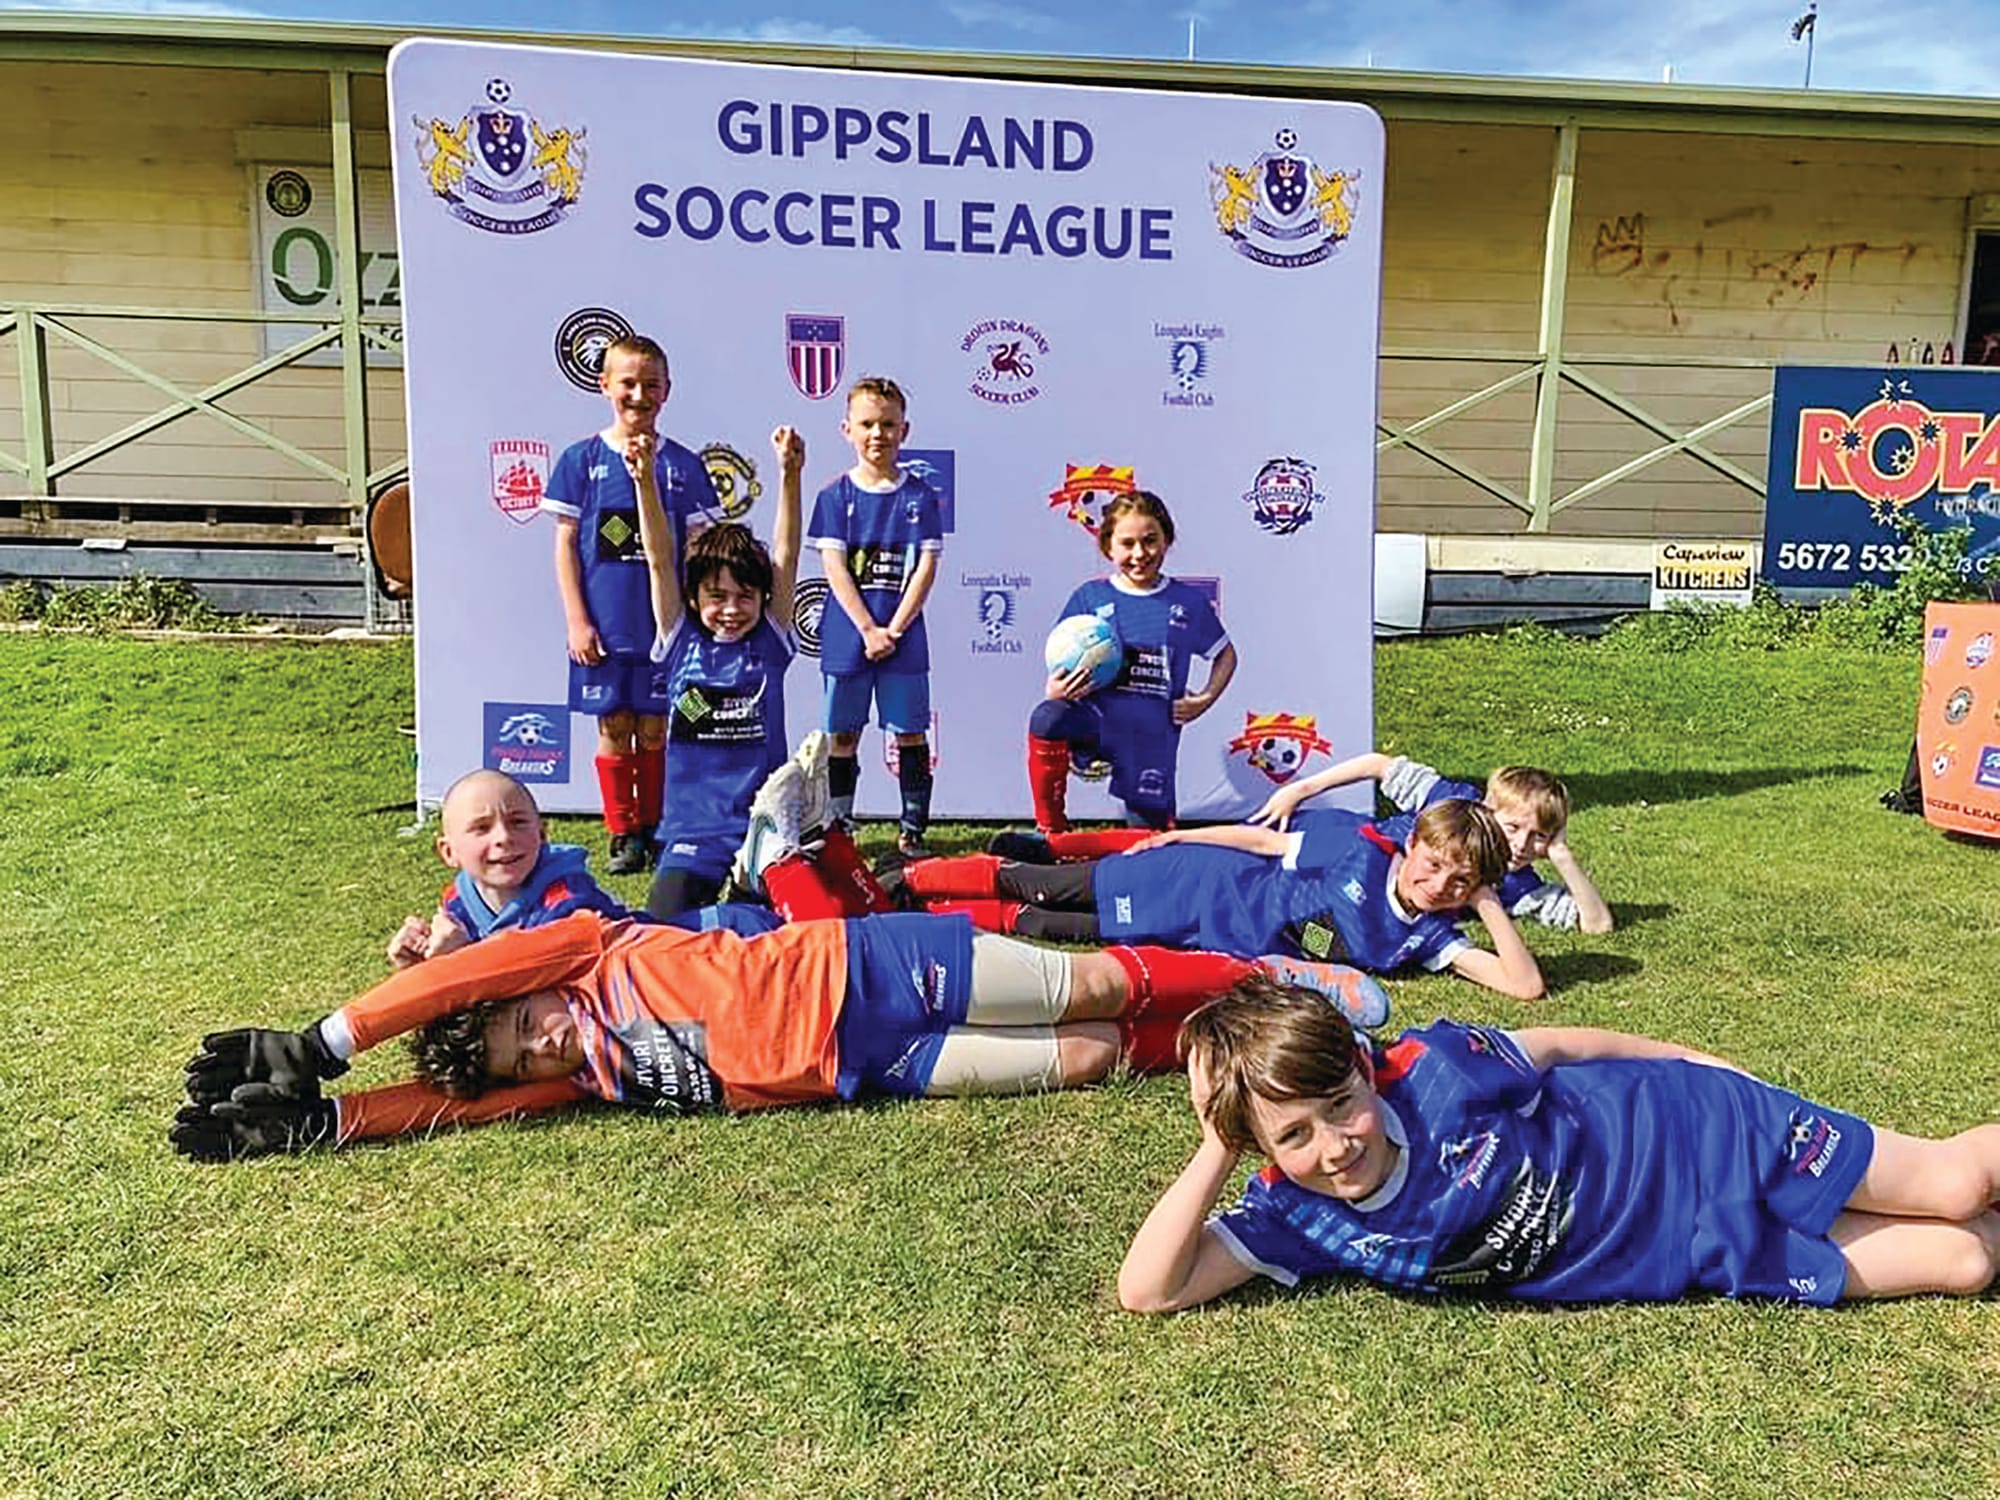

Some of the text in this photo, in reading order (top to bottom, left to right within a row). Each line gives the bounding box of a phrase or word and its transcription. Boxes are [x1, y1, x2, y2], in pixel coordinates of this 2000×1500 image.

[718, 99, 1094, 171] GIPPSLAND
[633, 183, 1173, 260] SOCCER LEAGUE
[1000, 320, 1049, 354] DRAGONS
[1795, 398, 2000, 506] ROTA
[1660, 566, 1747, 588] KITCHENS
[1777, 543, 1850, 571] 5672
